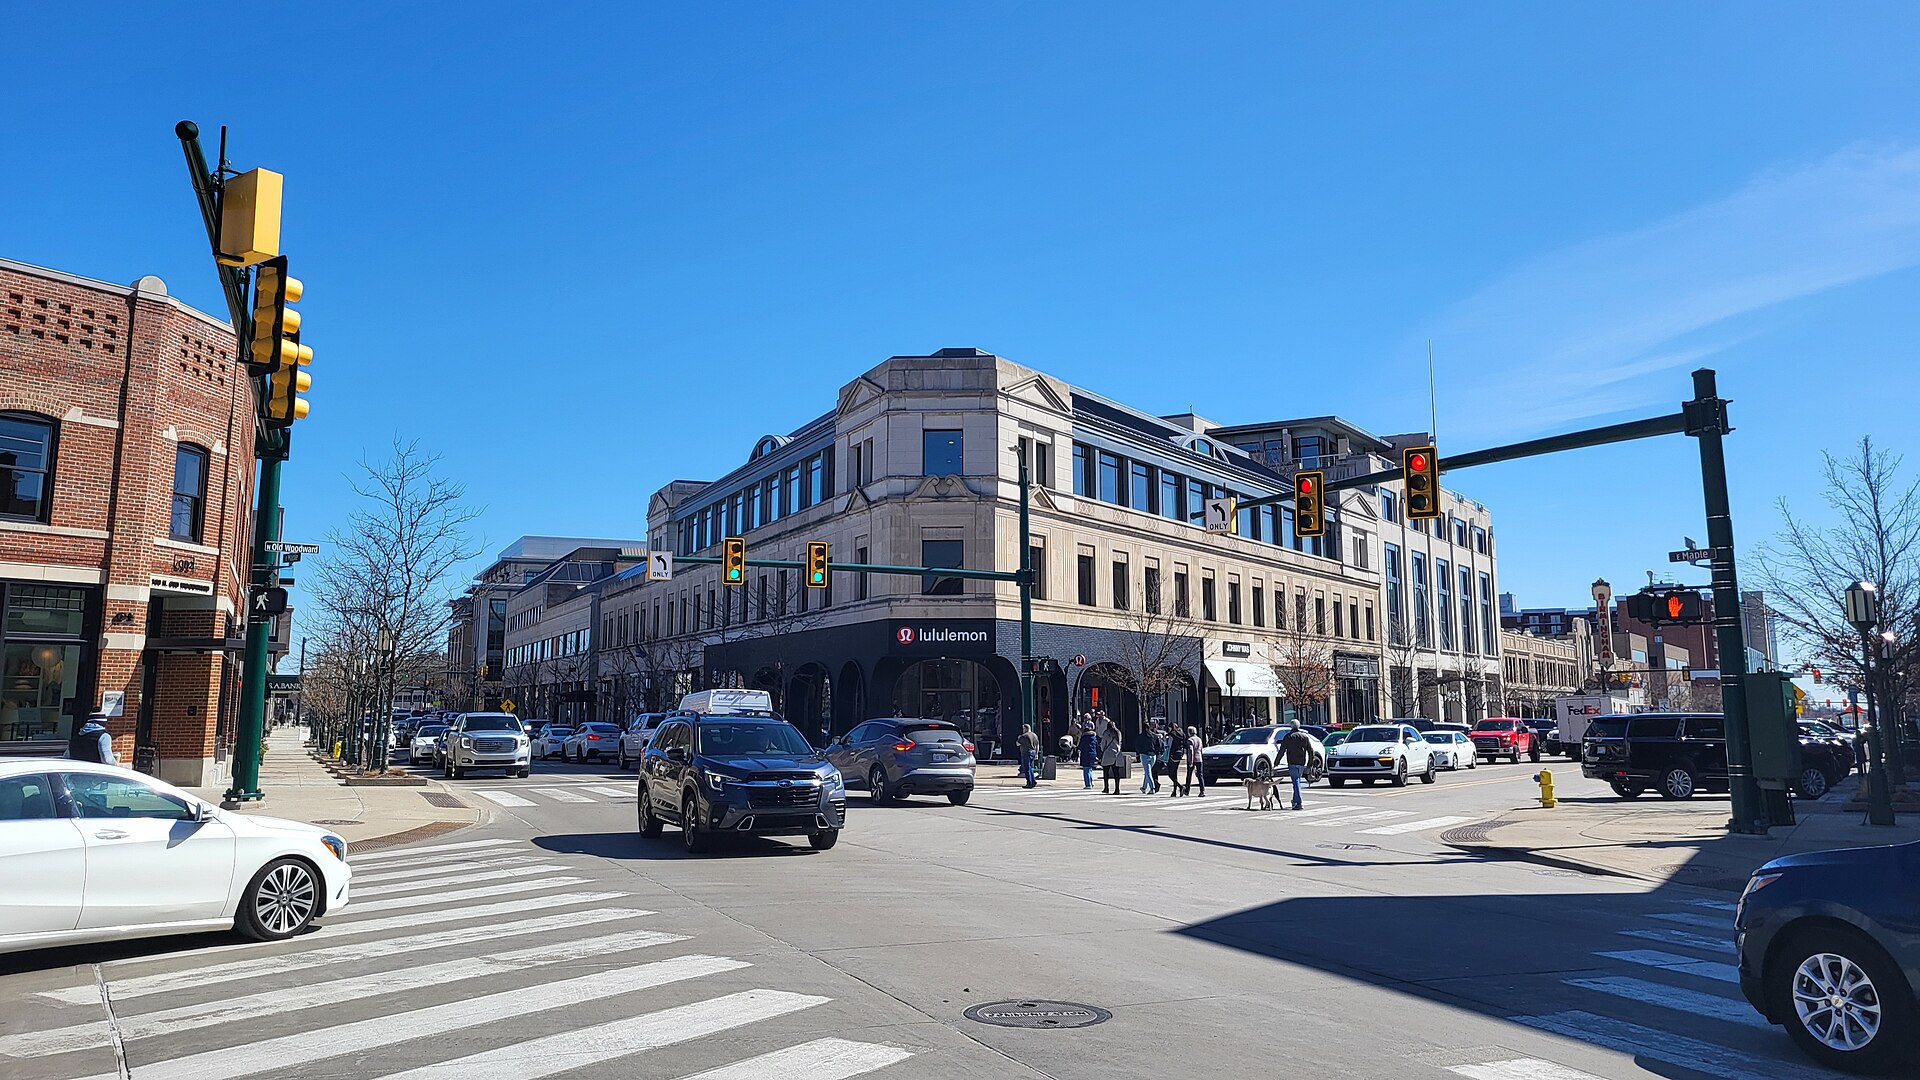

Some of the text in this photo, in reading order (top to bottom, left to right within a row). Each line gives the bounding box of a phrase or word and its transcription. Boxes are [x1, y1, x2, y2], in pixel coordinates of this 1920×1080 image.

[1209, 523, 1228, 531] ONLY
[271, 543, 283, 551] Old
[284, 544, 318, 554] Woodward
[1682, 550, 1708, 561] Maple
[1597, 593, 1611, 659] BIRMINGHAM
[919, 628, 987, 642] lululemon
[1567, 704, 1600, 715] FedEx
